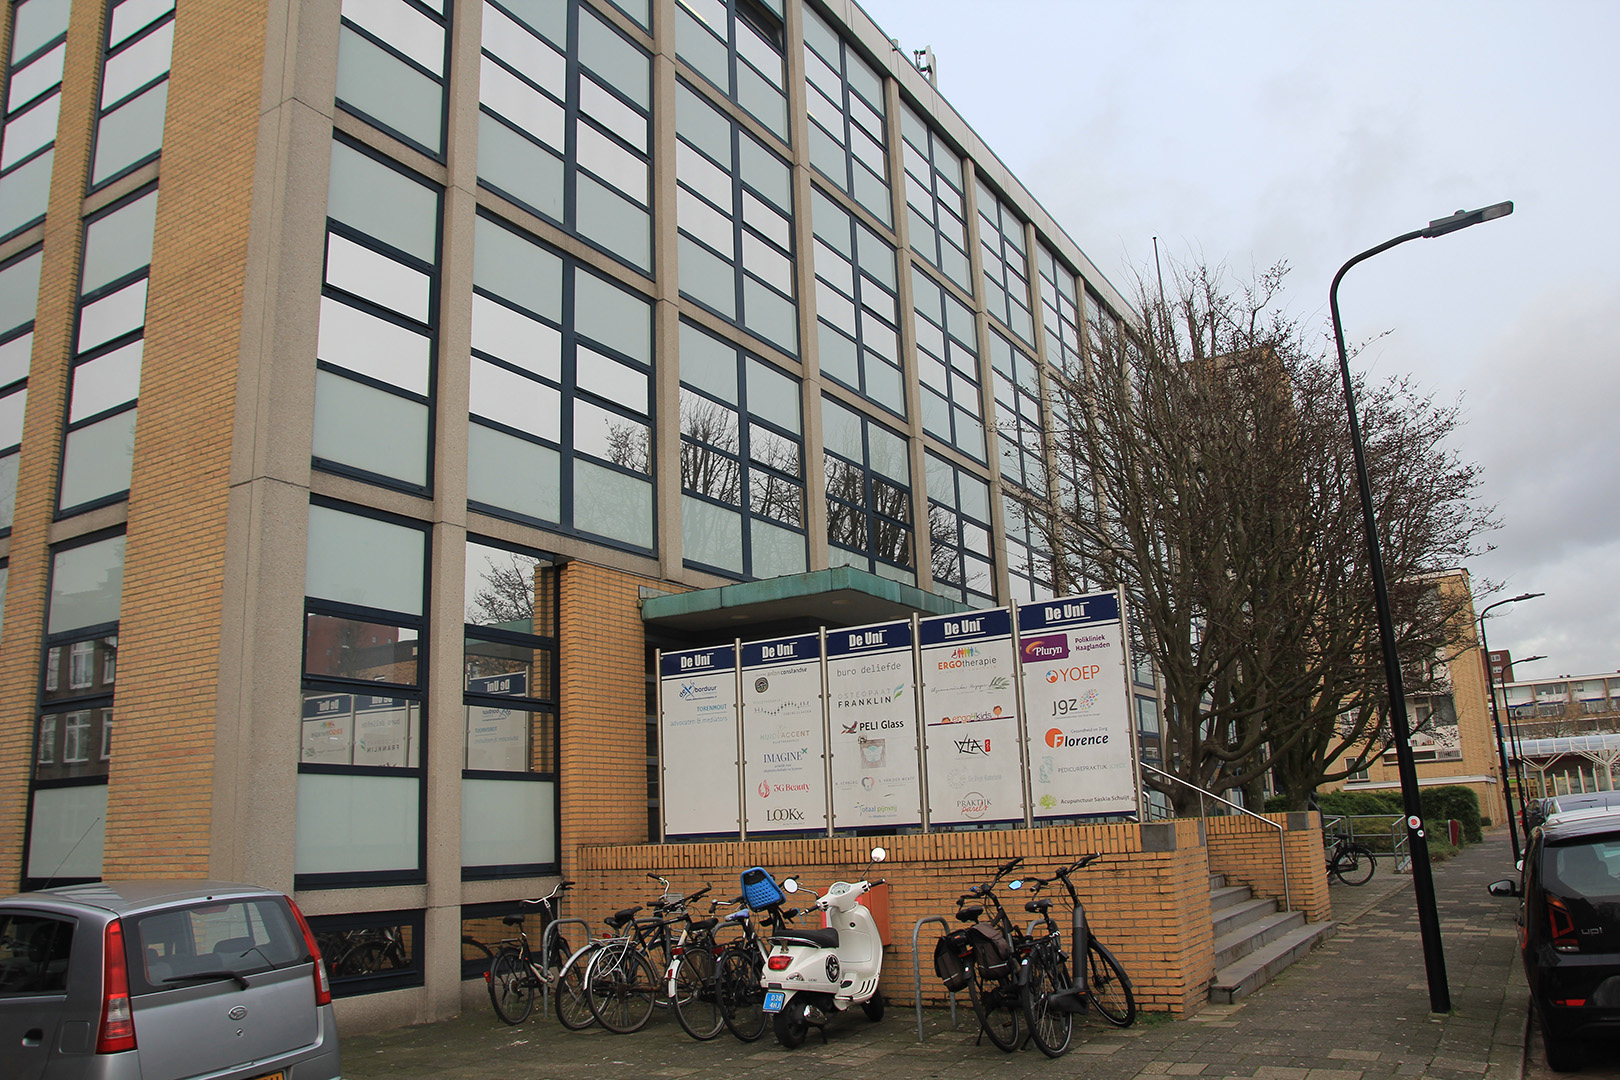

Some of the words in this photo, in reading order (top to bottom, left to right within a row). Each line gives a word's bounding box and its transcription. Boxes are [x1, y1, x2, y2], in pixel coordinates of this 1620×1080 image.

[1045, 607, 1061, 620] De
[1064, 602, 1087, 617] Uni
[944, 622, 959, 635] De
[961, 618, 983, 632] Uni
[849, 634, 862, 647] De
[865, 630, 885, 644] Uni
[1075, 634, 1105, 643] Polikliniek
[762, 646, 775, 658] De
[777, 642, 796, 656] Uni
[1034, 646, 1063, 657] Pluryn
[1075, 642, 1110, 651] Haaglanden
[681, 656, 692, 668] De
[694, 653, 712, 667] Uni
[938, 656, 997, 670] ERGOtherapie
[837, 669, 856, 677] buro
[861, 662, 901, 674] deliefde
[1059, 664, 1100, 682] YOEP
[694, 685, 717, 693] borduur
[837, 688, 891, 700] OSTEOPAAT
[838, 696, 891, 709] FRANKLIN
[859, 721, 878, 731] PELI
[881, 719, 904, 730] Glass
[1054, 734, 1109, 749] Florence
[785, 783, 811, 793] Beauty
[1061, 797, 1093, 805] Acupunctuur
[1581, 926, 1603, 936] up!
